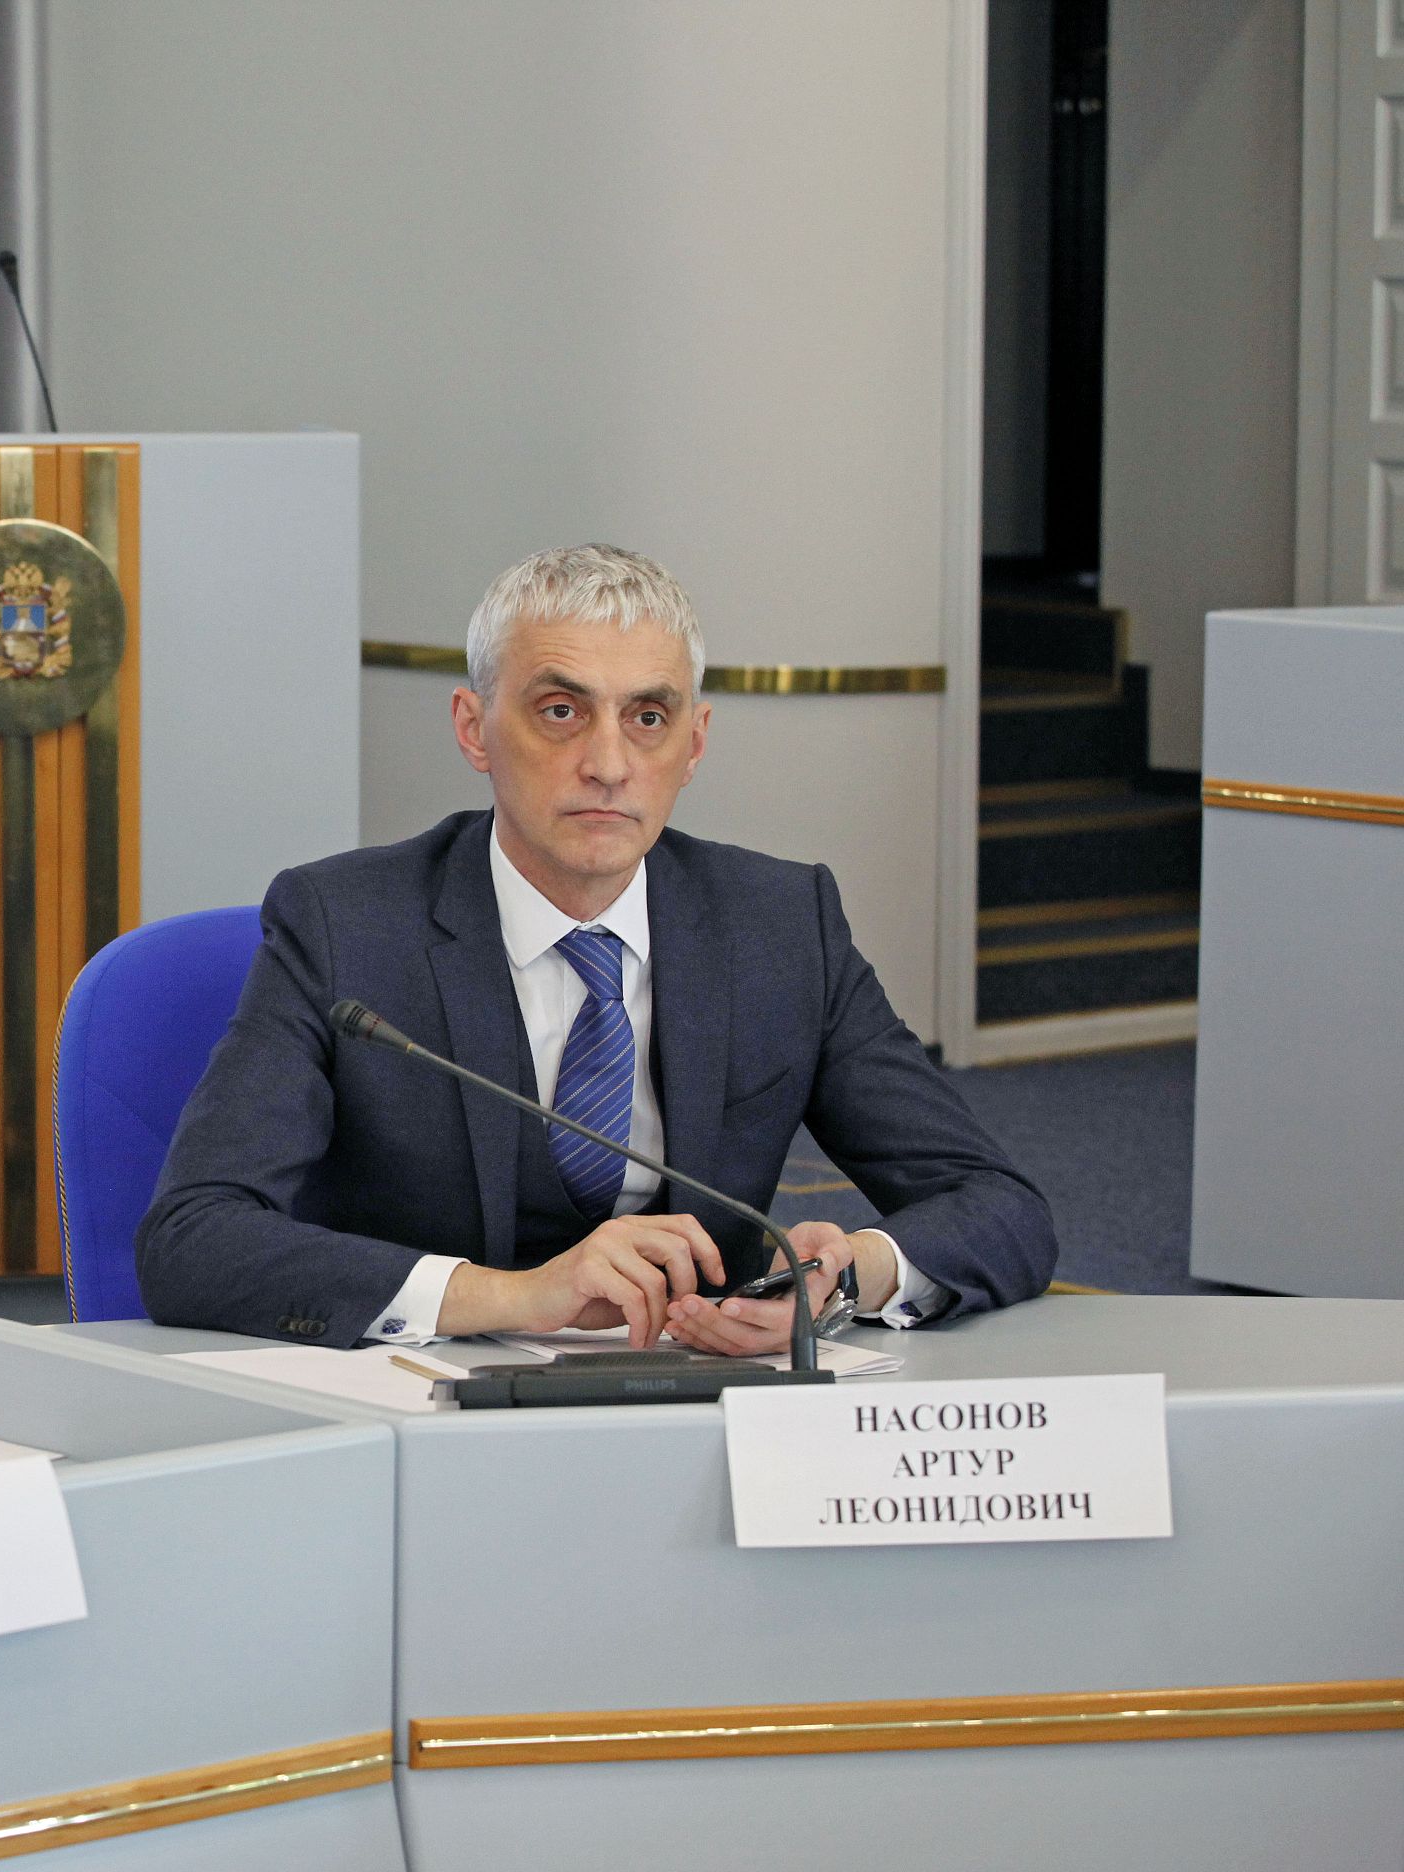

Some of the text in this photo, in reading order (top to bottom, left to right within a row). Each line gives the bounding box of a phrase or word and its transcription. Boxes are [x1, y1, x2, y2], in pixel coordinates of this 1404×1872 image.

[623, 1378, 677, 1391] PHILIPS
[854, 1402, 1048, 1433] НАСОНОВ
[892, 1448, 1015, 1479] АРТУР
[819, 1492, 1094, 1526] ЛЕОНИДОВИЧ
